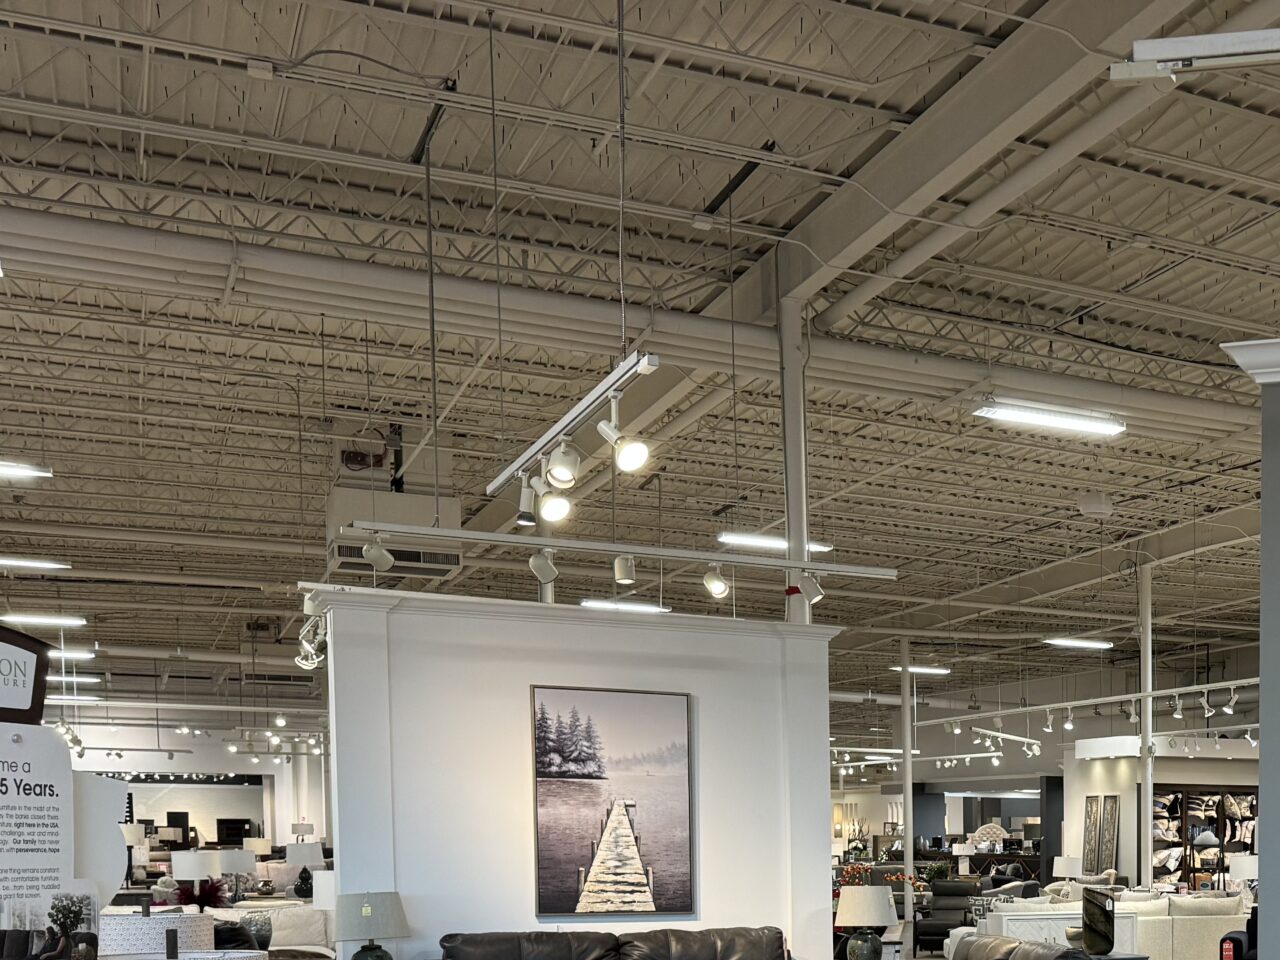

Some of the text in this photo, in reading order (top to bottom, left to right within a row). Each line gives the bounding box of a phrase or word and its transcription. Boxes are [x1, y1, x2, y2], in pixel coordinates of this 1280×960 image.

[0, 658, 27, 678] ON
[4, 677, 27, 689] URE
[22, 762, 31, 773] a
[0, 778, 59, 798] 5 Years.
[22, 838, 37, 846] family
